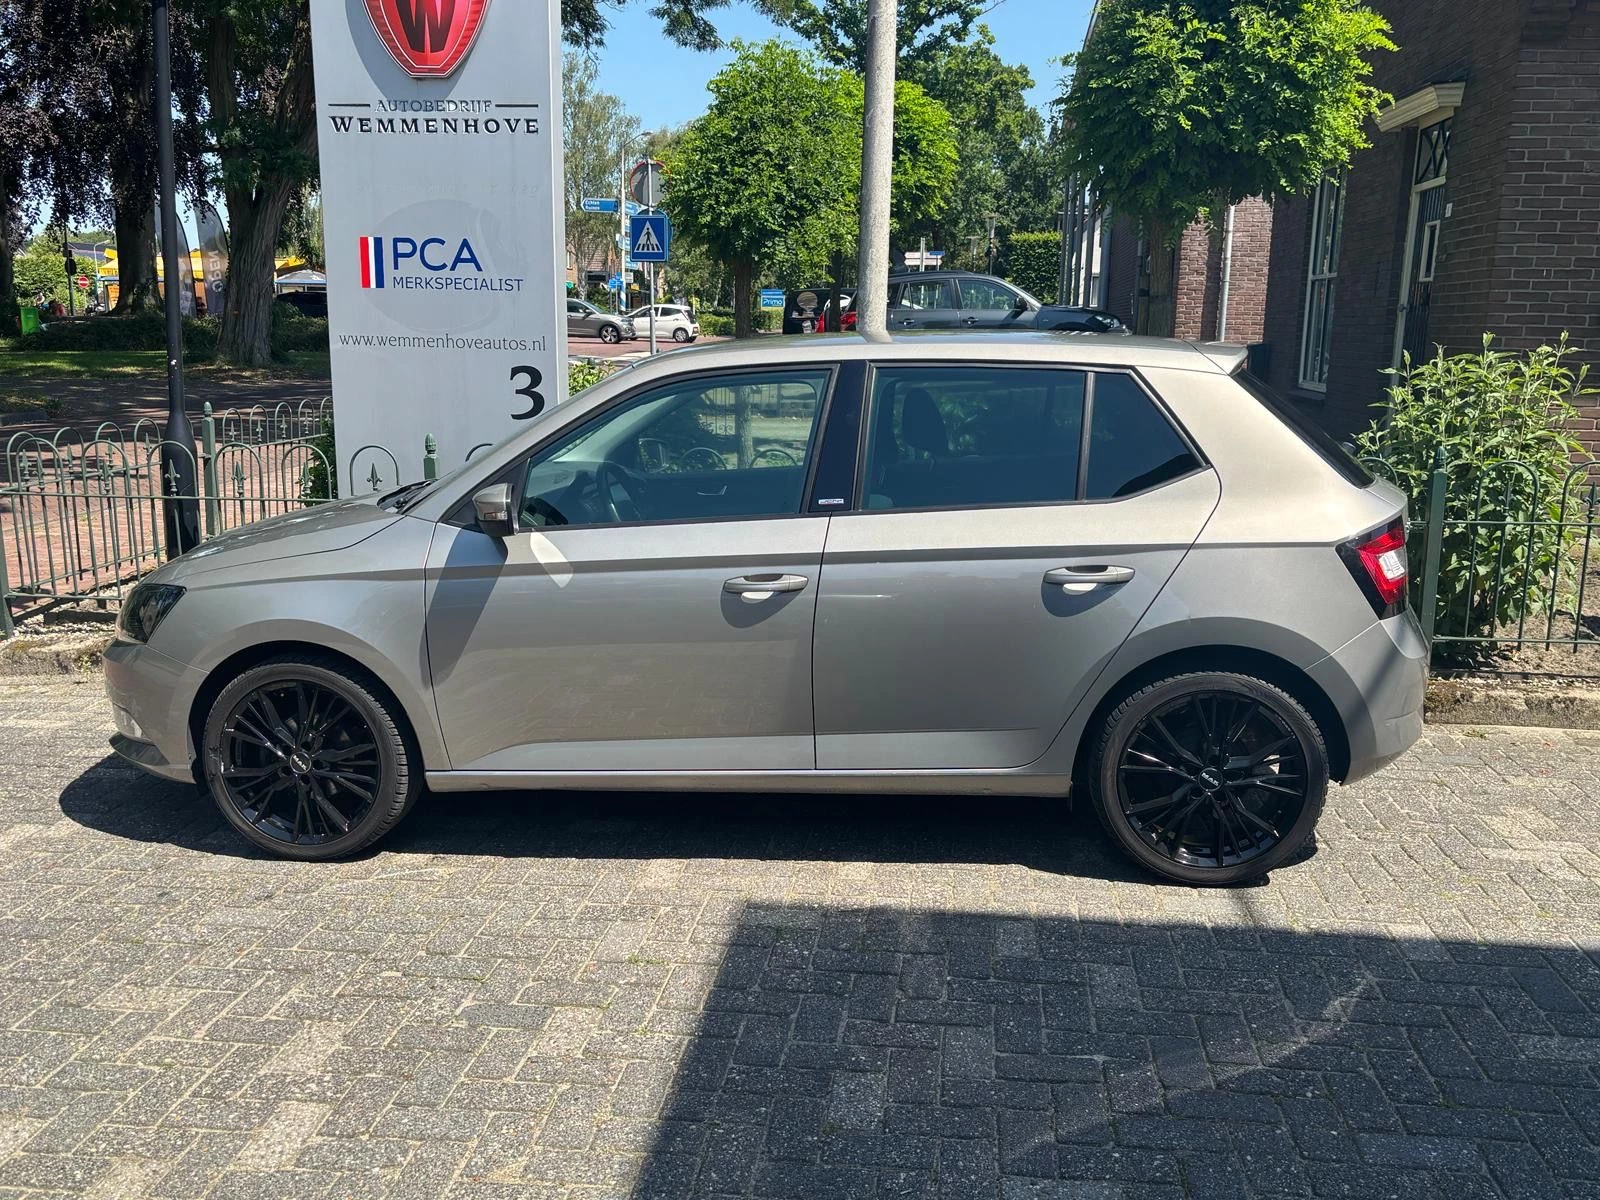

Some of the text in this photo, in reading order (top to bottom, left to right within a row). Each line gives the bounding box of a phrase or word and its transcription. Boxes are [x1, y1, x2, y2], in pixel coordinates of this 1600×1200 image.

[374, 99, 493, 115] AUTOBEDRIJF
[328, 116, 540, 135] WEMMENHOVE
[392, 236, 484, 272] PCA
[392, 276, 525, 292] MERKSPECIALIST
[338, 333, 547, 352] www.wemmenhoveautos.nl
[509, 364, 546, 421] 3
